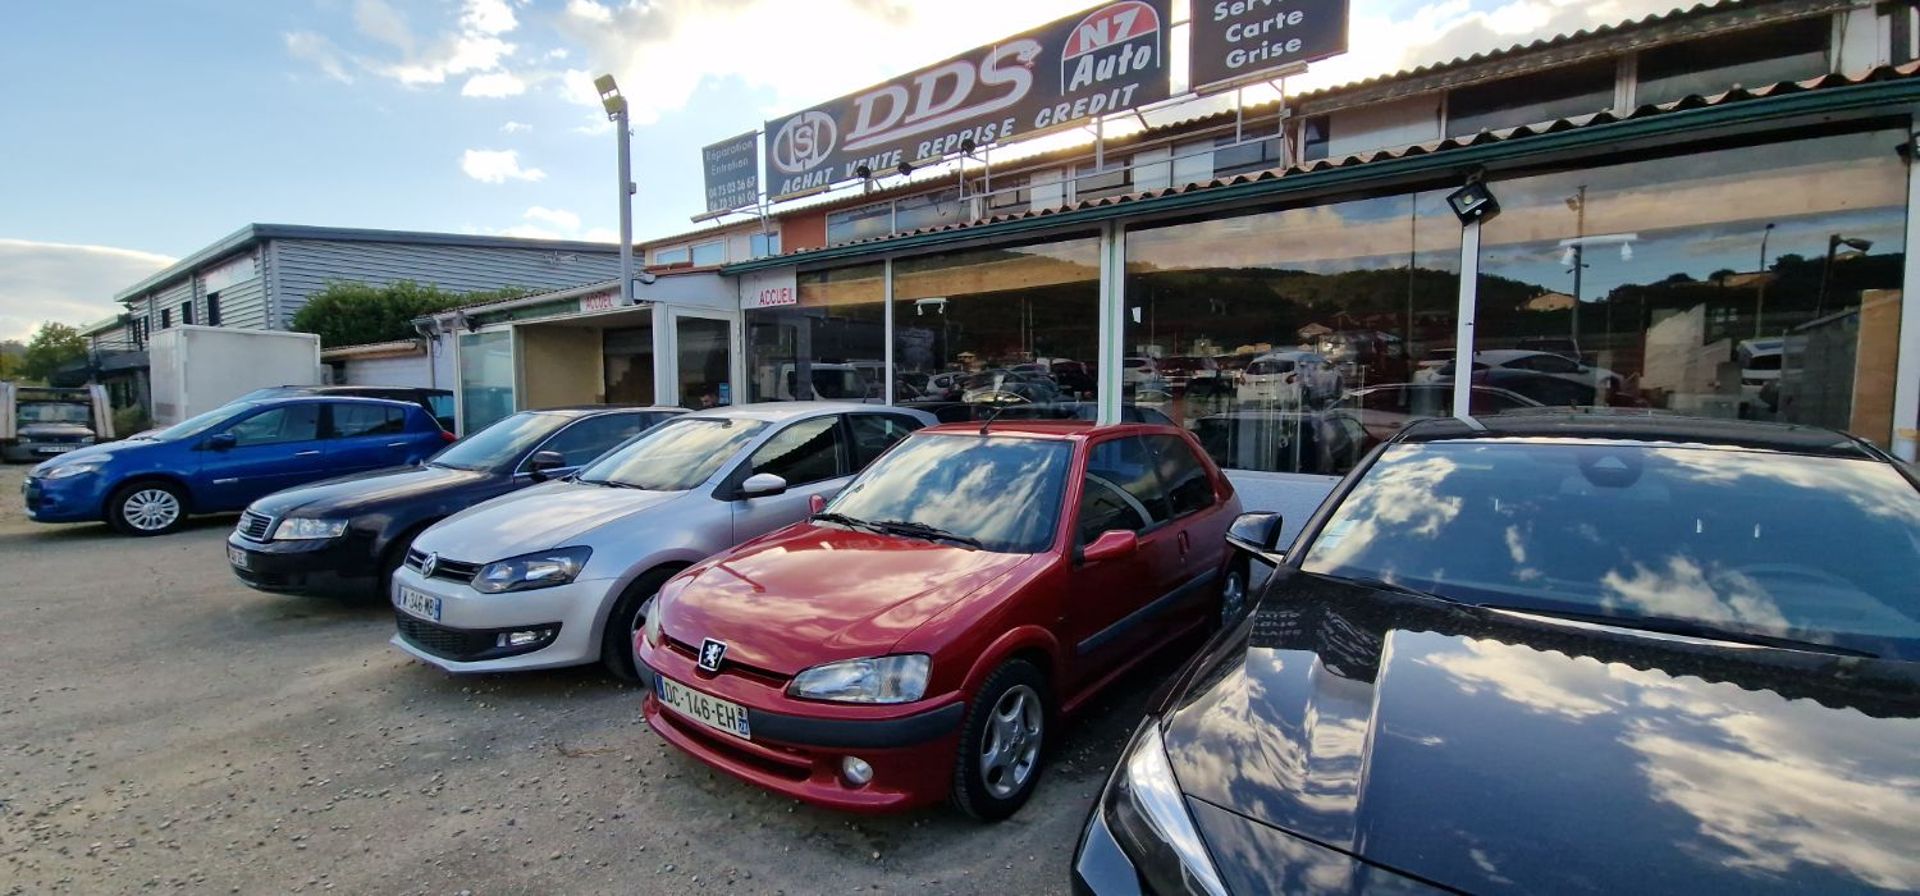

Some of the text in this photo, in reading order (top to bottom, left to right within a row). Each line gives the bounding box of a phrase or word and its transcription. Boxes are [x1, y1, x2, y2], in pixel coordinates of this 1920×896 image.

[1080, 7, 1140, 52] N7
[1225, 10, 1304, 42] Carte
[1069, 44, 1152, 91] Auto
[1225, 38, 1302, 68] Grise
[844, 39, 1042, 146] DDS
[781, 167, 834, 196] ACHAT
[846, 149, 903, 177] VENTE
[1035, 83, 1139, 129] CREDIT
[585, 293, 614, 310] ACCUEIL
[759, 288, 797, 305] ACCUEIL
[665, 681, 737, 731] DC-146-EH
